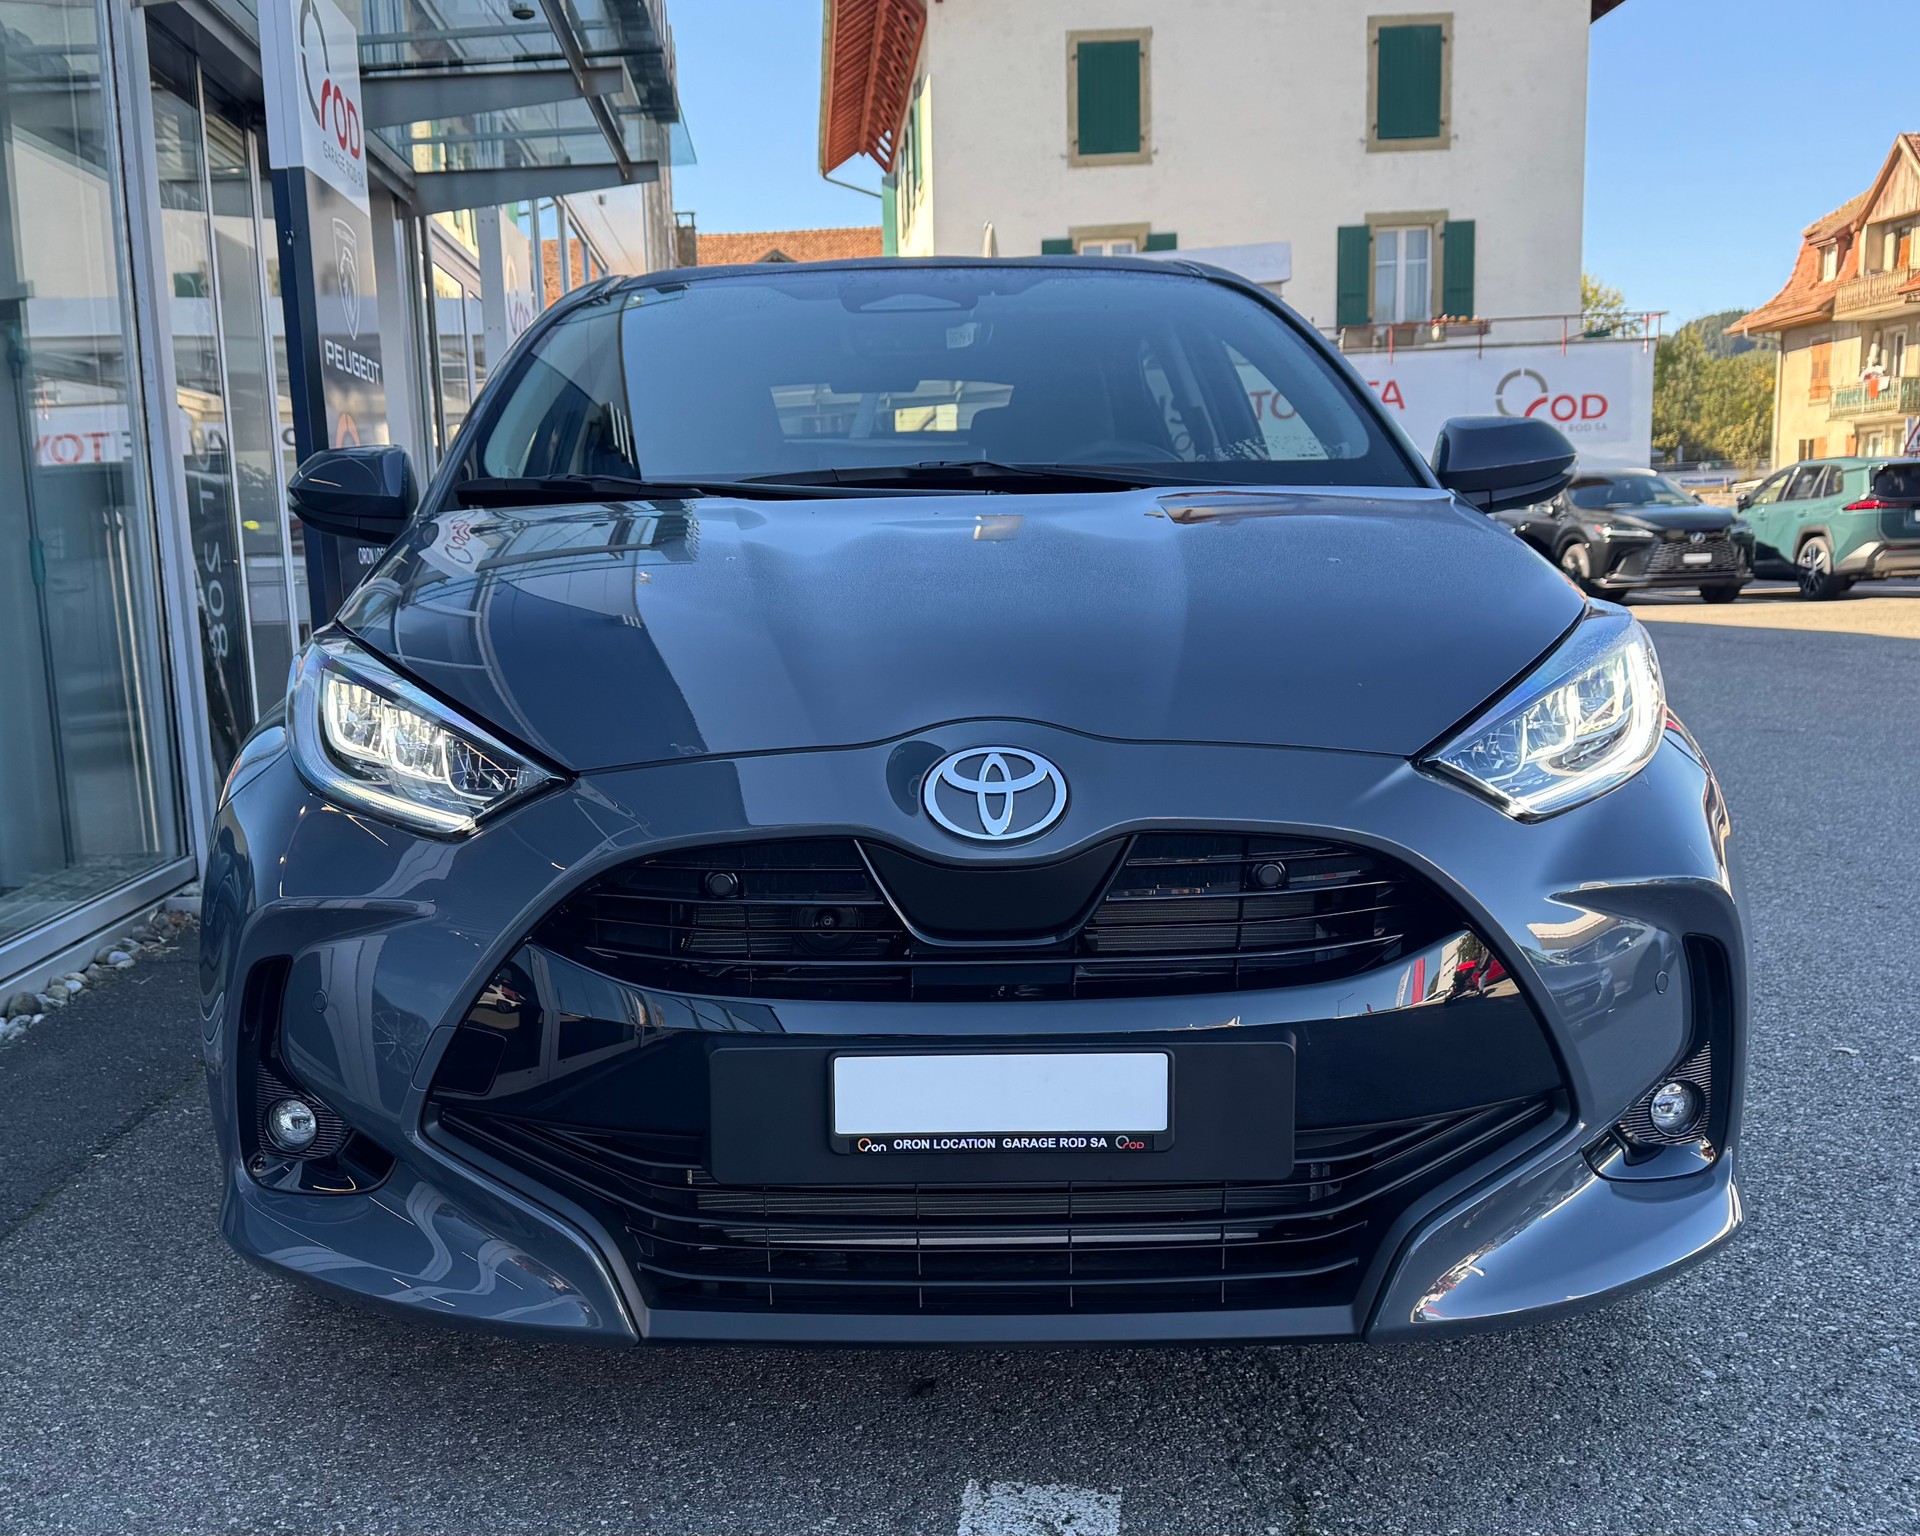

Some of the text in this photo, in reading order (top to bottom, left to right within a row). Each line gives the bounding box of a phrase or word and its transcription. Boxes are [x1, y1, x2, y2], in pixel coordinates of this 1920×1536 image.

[325, 340, 380, 385] PEUGEOT
[893, 1139, 930, 1149] ORON
[933, 1139, 996, 1149] LOCATION
[1002, 1138, 1057, 1148] GARAGE
[1060, 1137, 1087, 1148] ROD
[1090, 1137, 1108, 1148] SA
